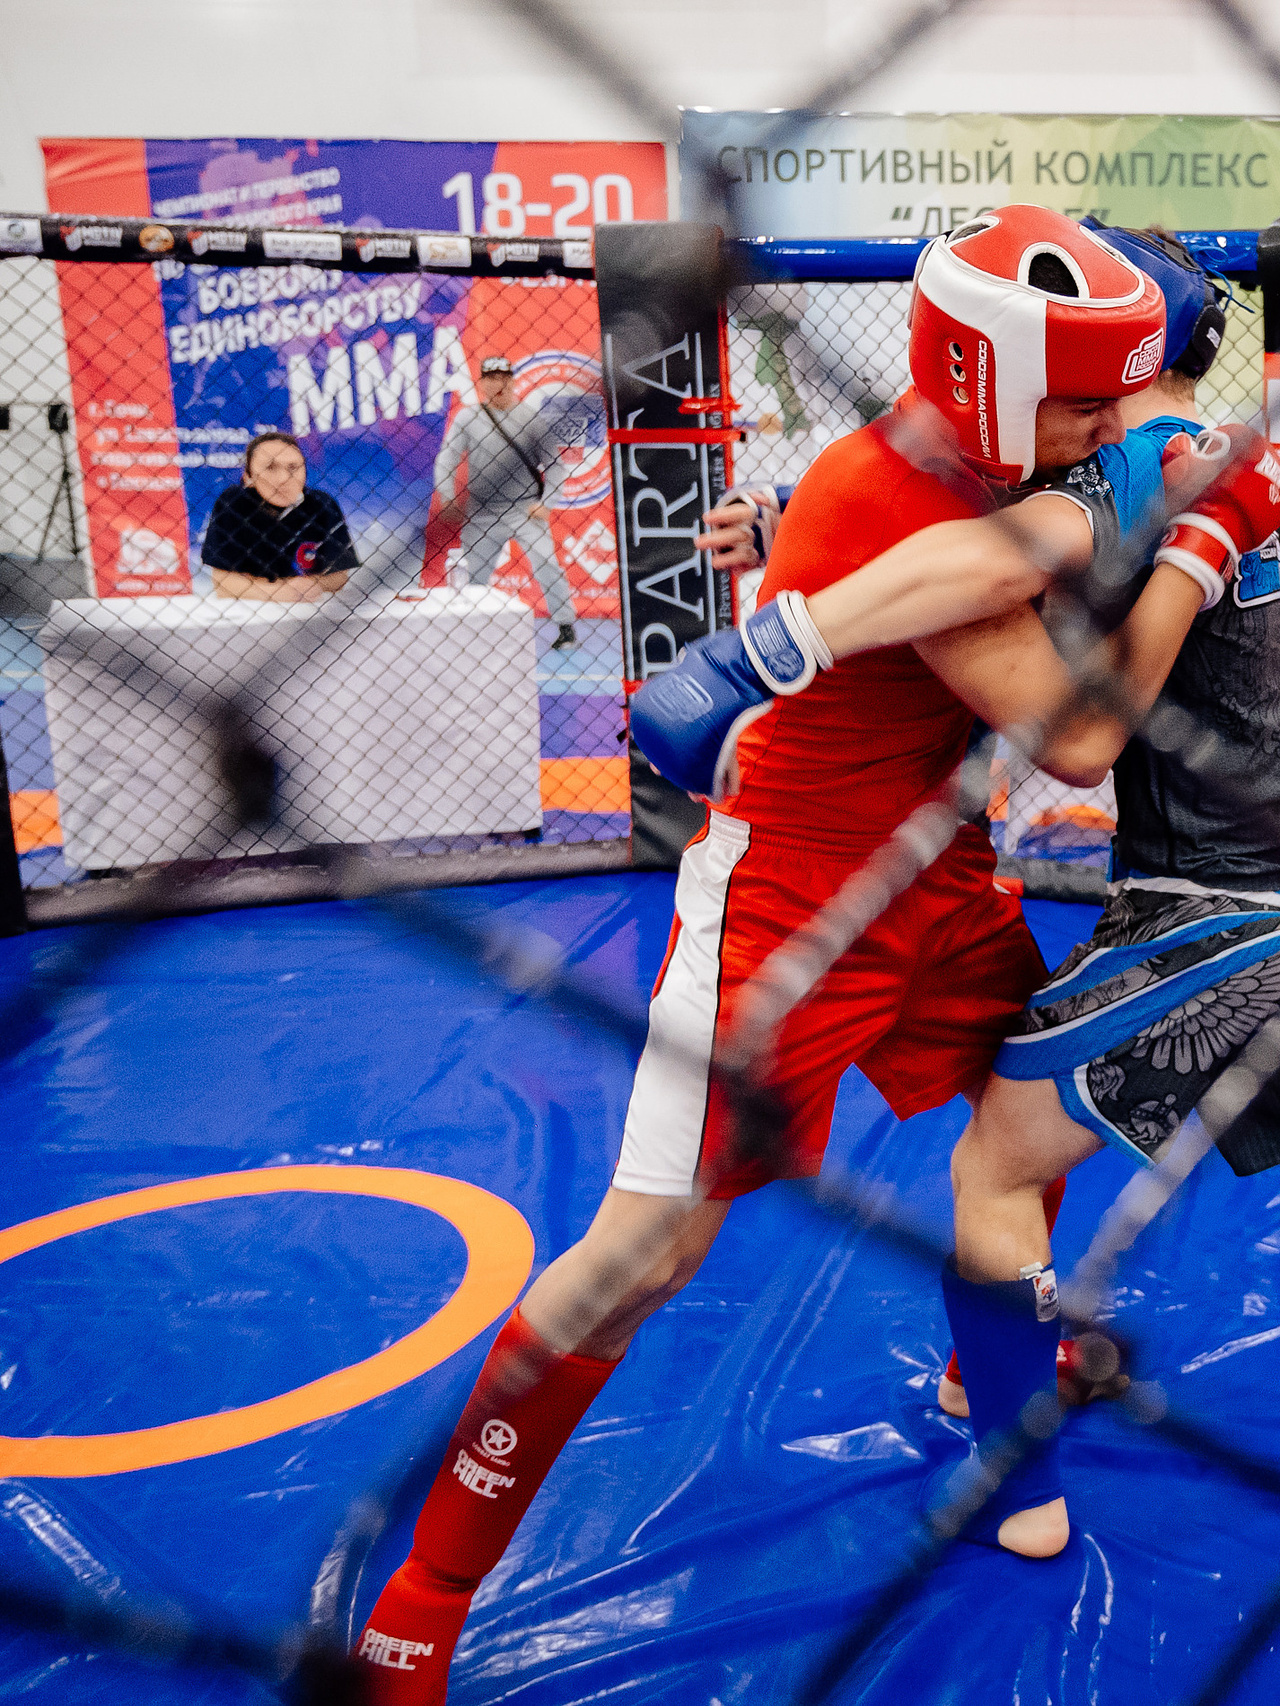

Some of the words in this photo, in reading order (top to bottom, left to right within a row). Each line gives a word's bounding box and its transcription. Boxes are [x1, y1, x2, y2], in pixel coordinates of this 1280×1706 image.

[718, 139, 1014, 185] СПОРТИВНЫЙ
[1034, 149, 1269, 188] КОМПЛЕКС
[441, 170, 635, 239] 18-20
[168, 279, 422, 364] ЕДИНОБОРСТВУ
[287, 326, 480, 438] ММА
[358, 1640, 417, 1671] HILL
[364, 1627, 435, 1657] GREEN
